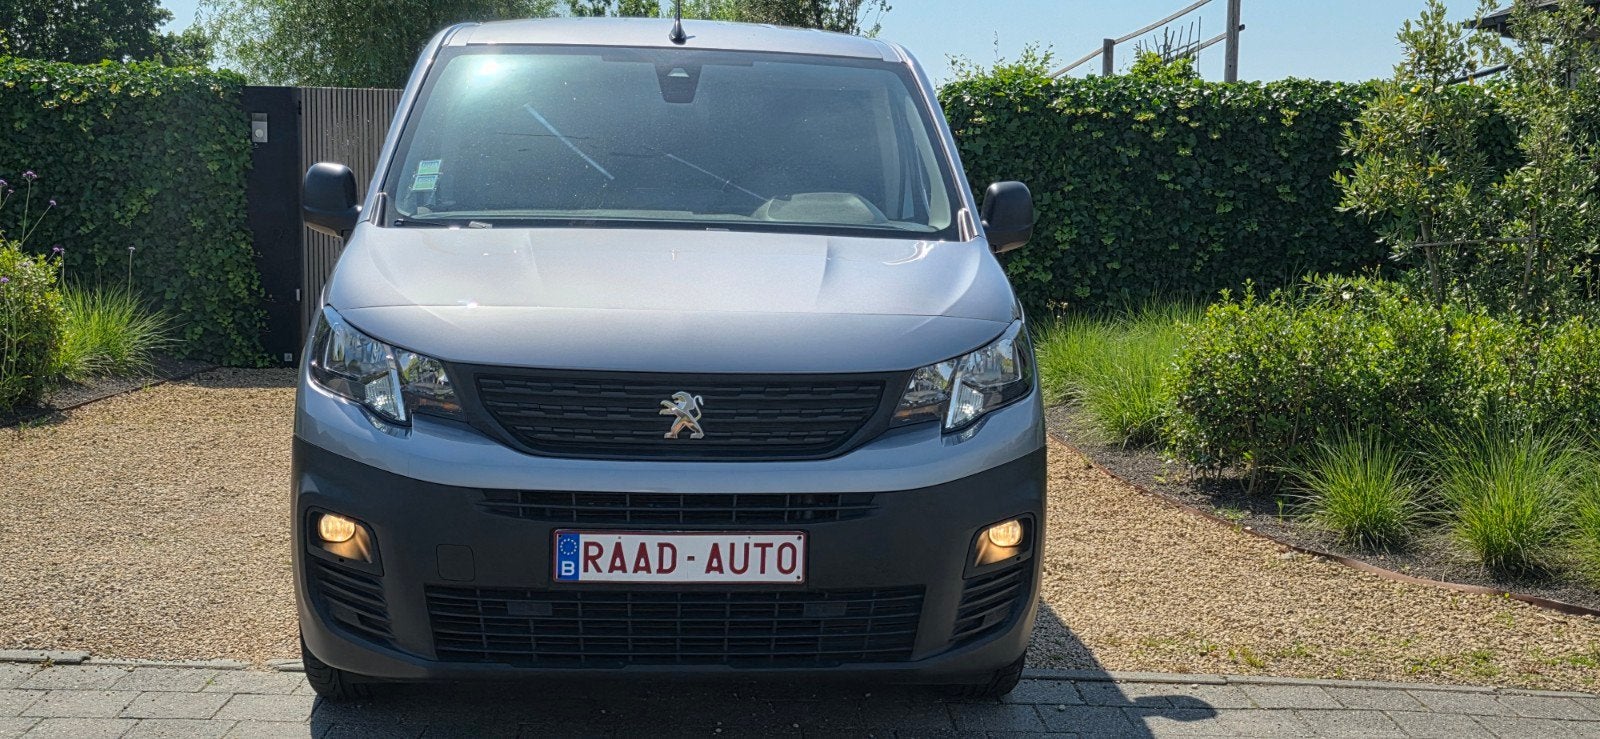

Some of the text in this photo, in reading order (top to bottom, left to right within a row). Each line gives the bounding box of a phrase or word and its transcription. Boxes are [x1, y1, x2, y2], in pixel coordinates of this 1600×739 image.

[561, 561, 575, 576] B
[583, 541, 678, 575] RAAD
[705, 542, 798, 575] AUTO
